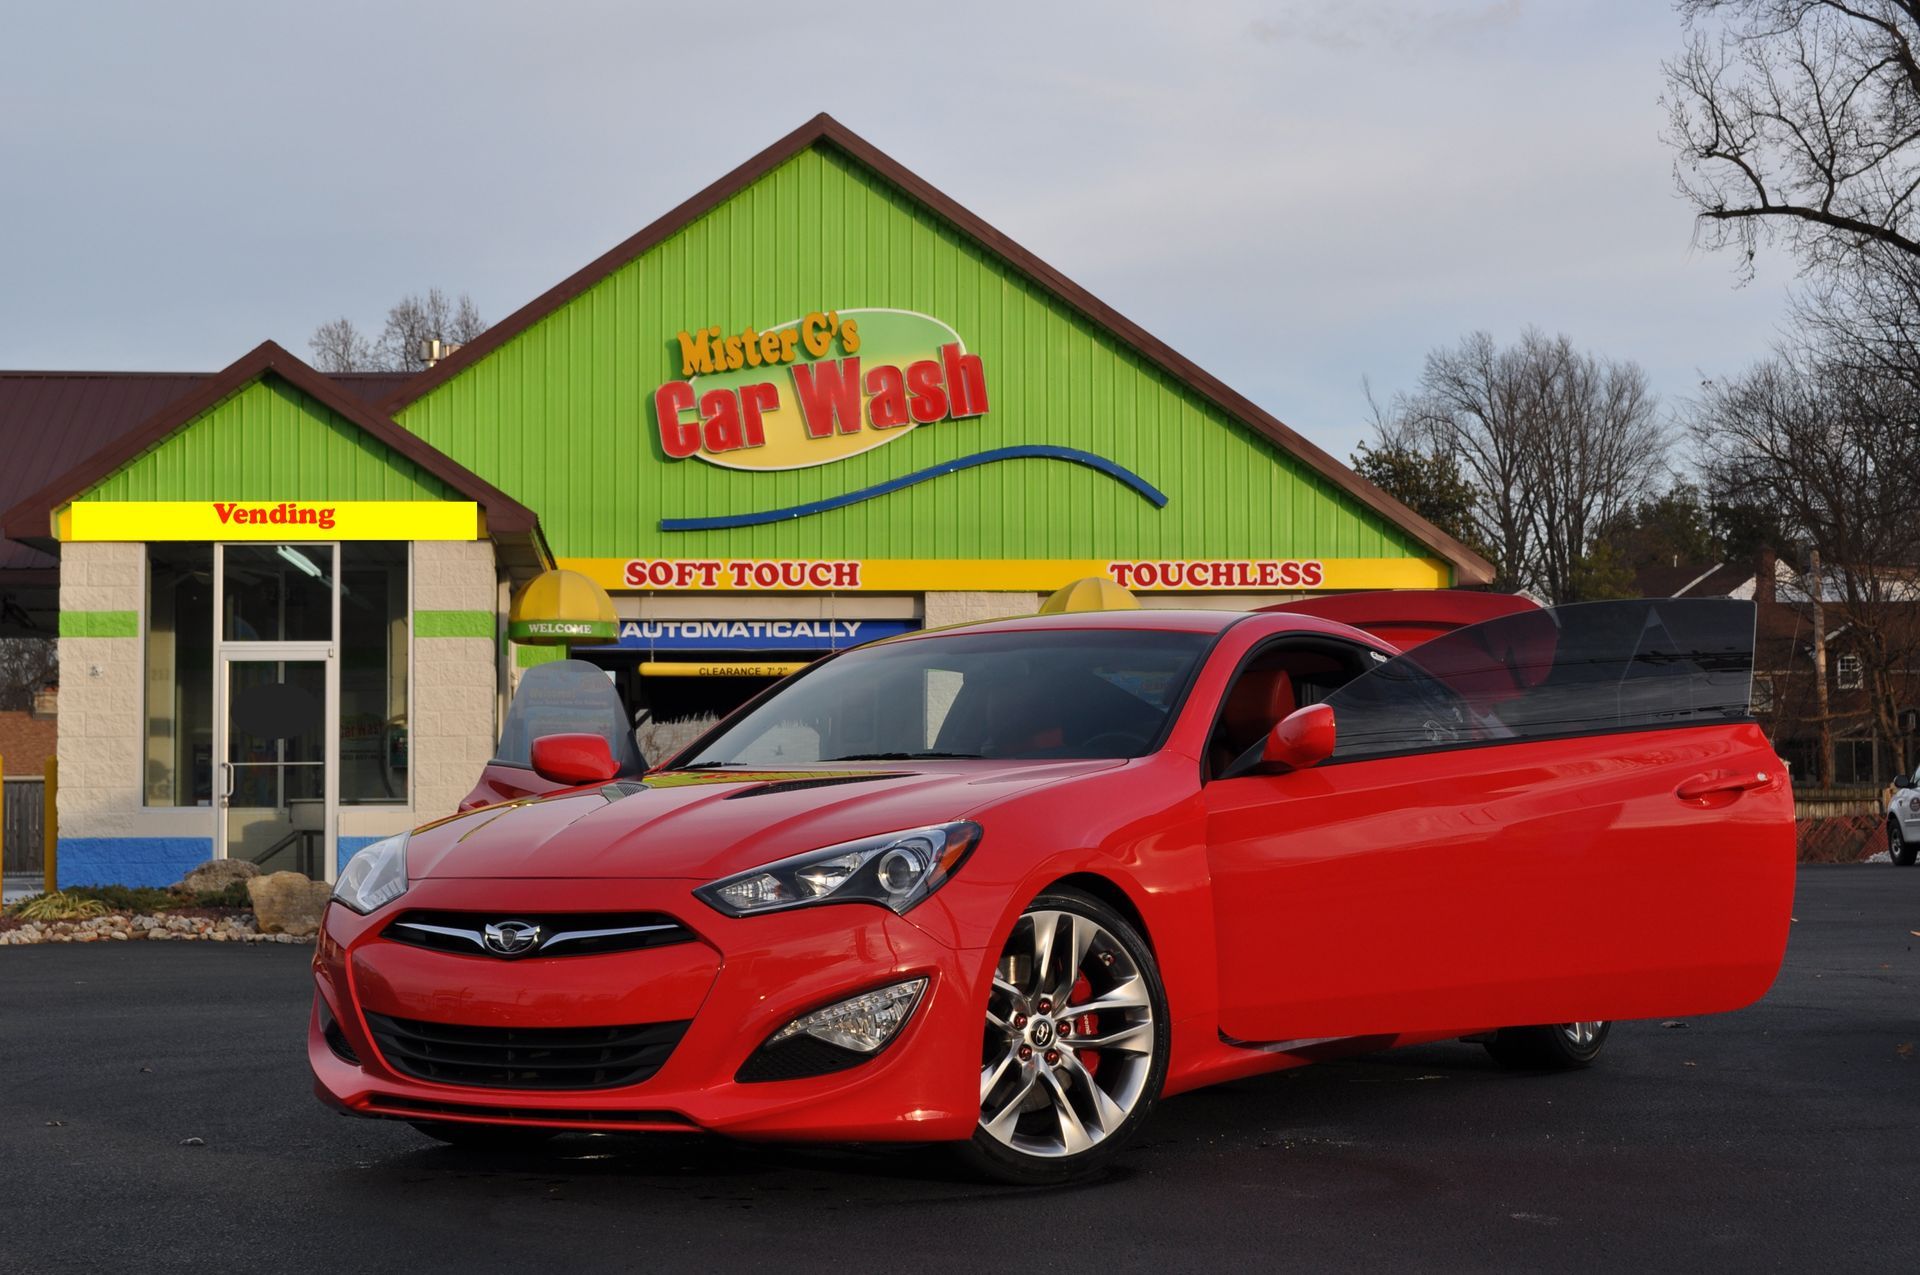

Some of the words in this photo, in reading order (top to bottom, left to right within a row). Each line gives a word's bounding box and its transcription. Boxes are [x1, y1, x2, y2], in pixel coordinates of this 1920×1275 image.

[677, 325, 799, 376] Mister
[802, 310, 861, 358] G's
[655, 381, 781, 458] Car
[790, 342, 990, 439] Wash
[213, 503, 336, 529] Vending
[625, 561, 722, 588] SOFT
[729, 561, 861, 588] TOUCH
[1109, 561, 1323, 588] TOUCHLESS
[528, 623, 592, 634] WELCOME
[620, 621, 862, 638] AUTOMATICALLY
[699, 667, 761, 676] CLEARANCE
